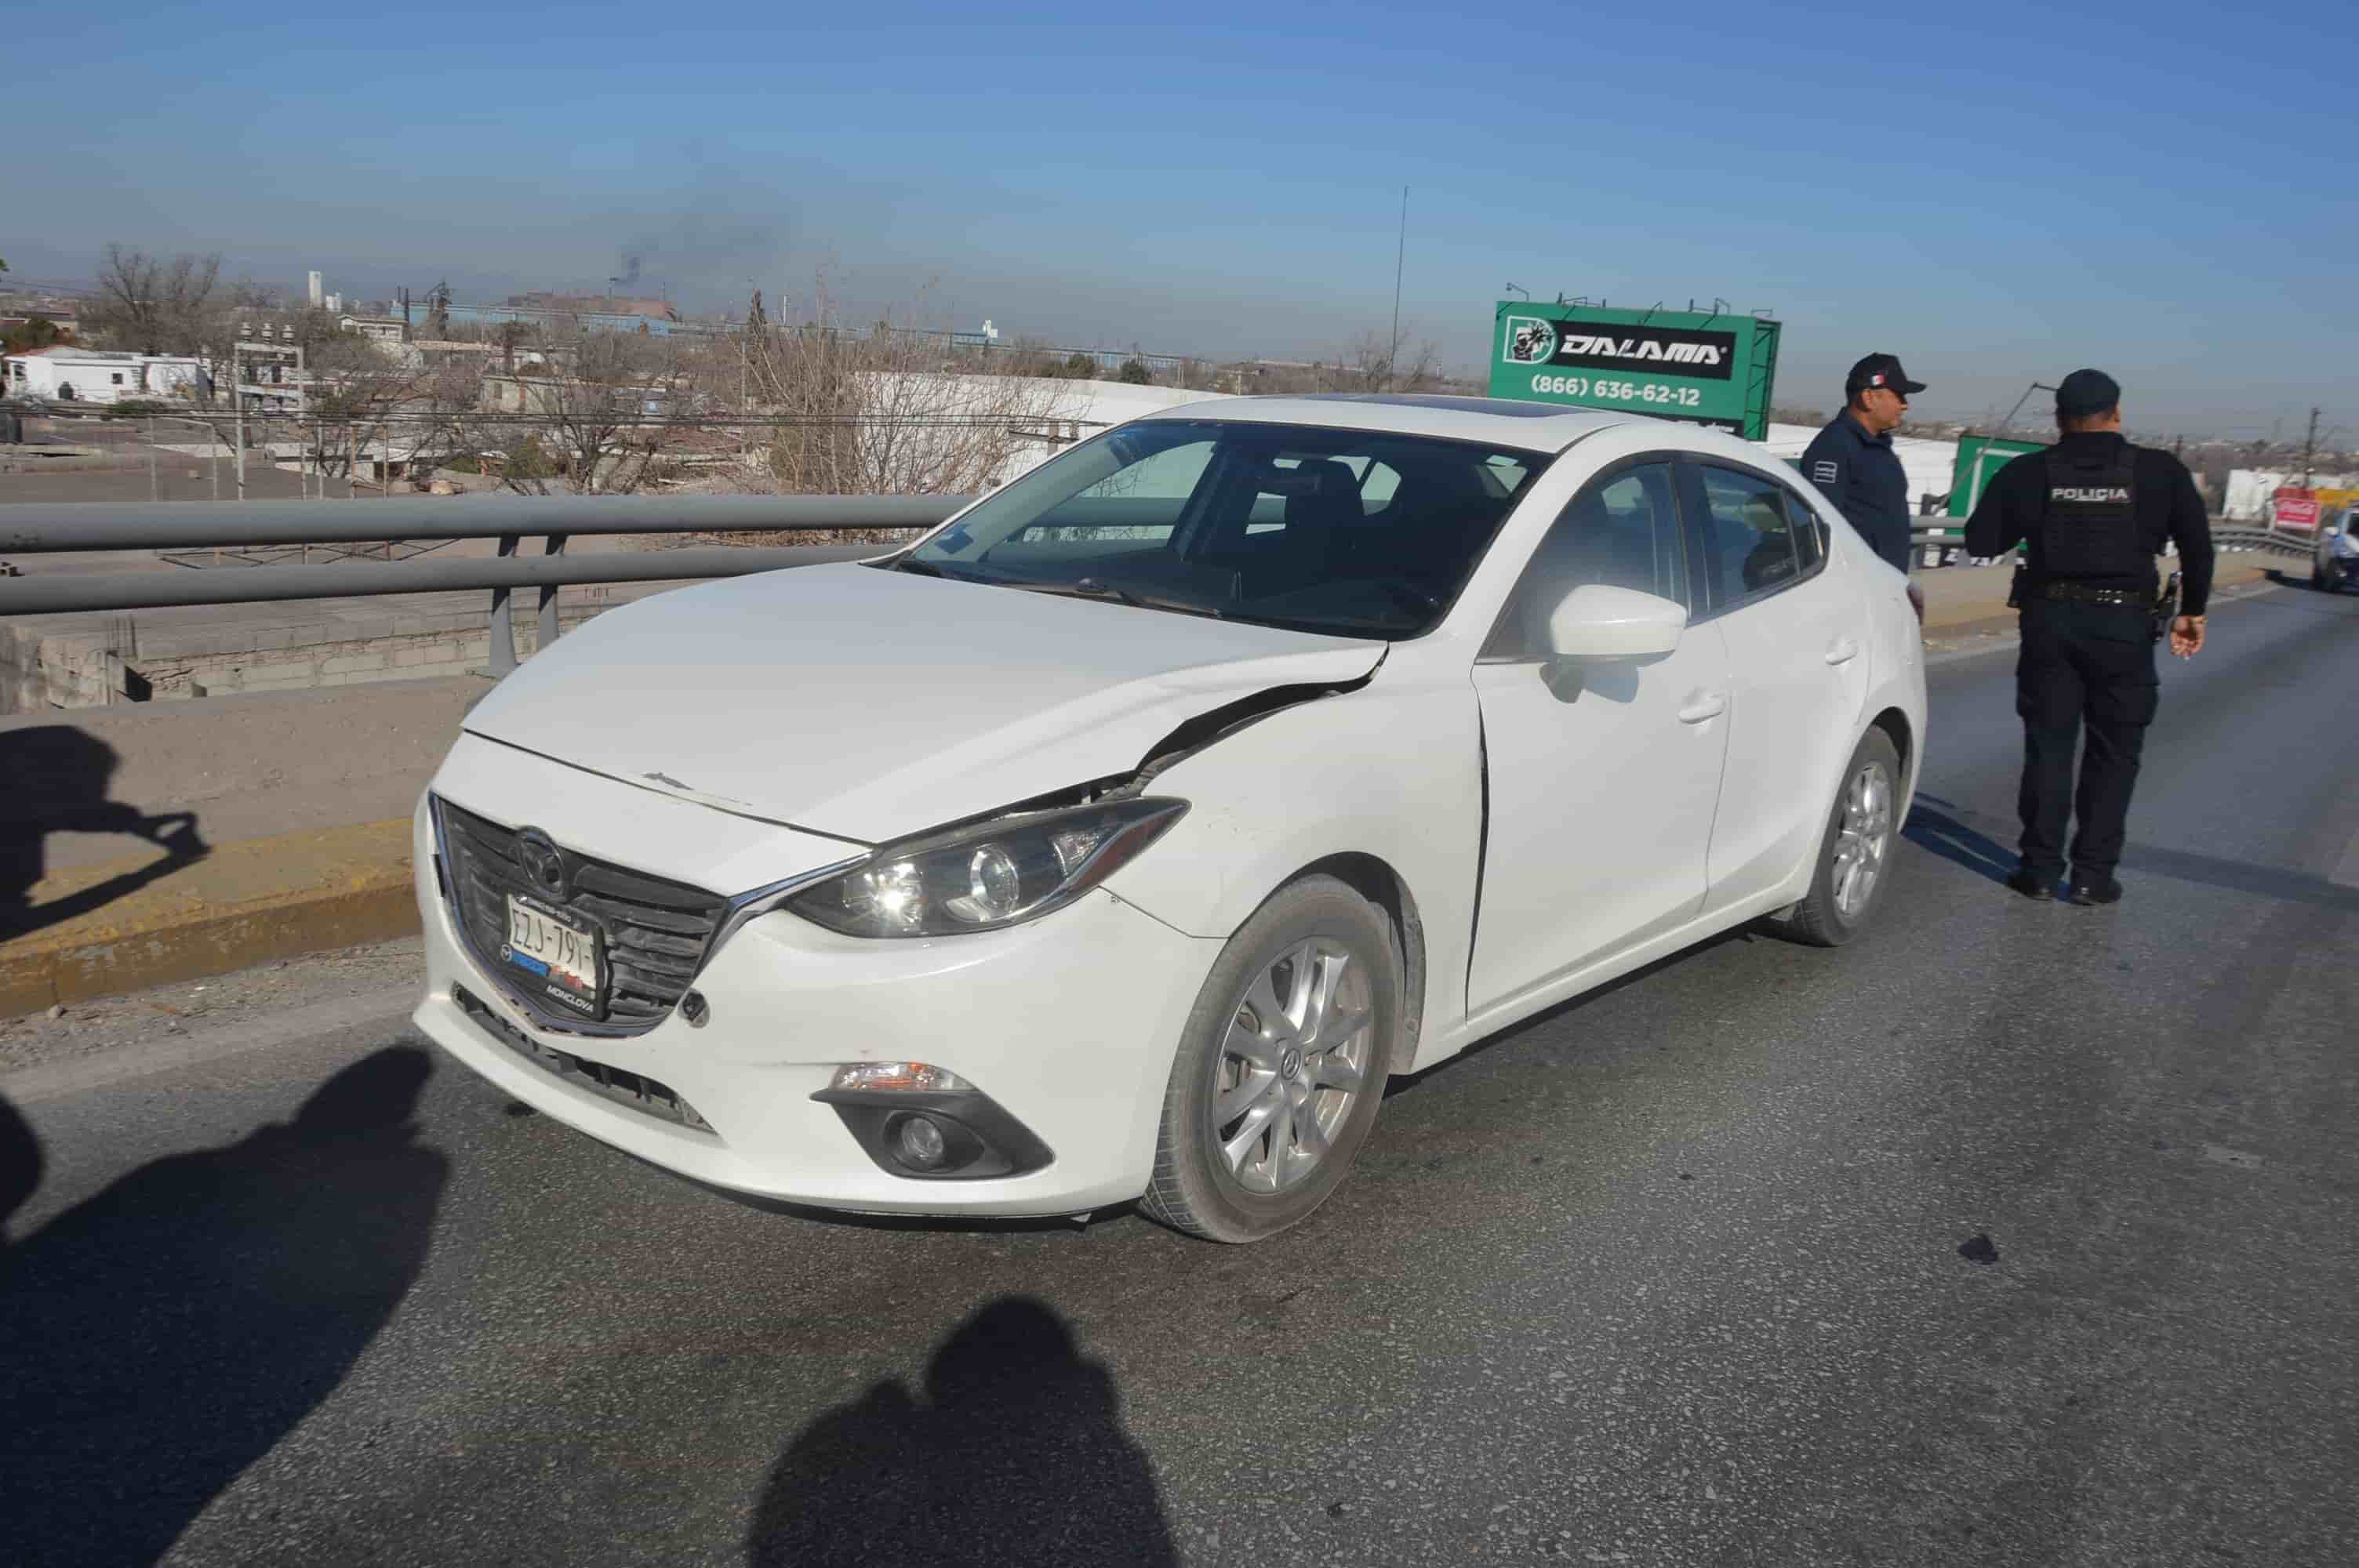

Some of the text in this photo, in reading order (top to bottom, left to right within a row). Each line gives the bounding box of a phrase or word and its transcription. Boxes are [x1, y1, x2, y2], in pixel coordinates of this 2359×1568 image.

[1559, 334, 1721, 365] DALAMA
[1531, 374, 1700, 406] (866) 636-62-12
[2051, 488, 2129, 502] POLICIA
[546, 984, 594, 1012] MONCLOVA
